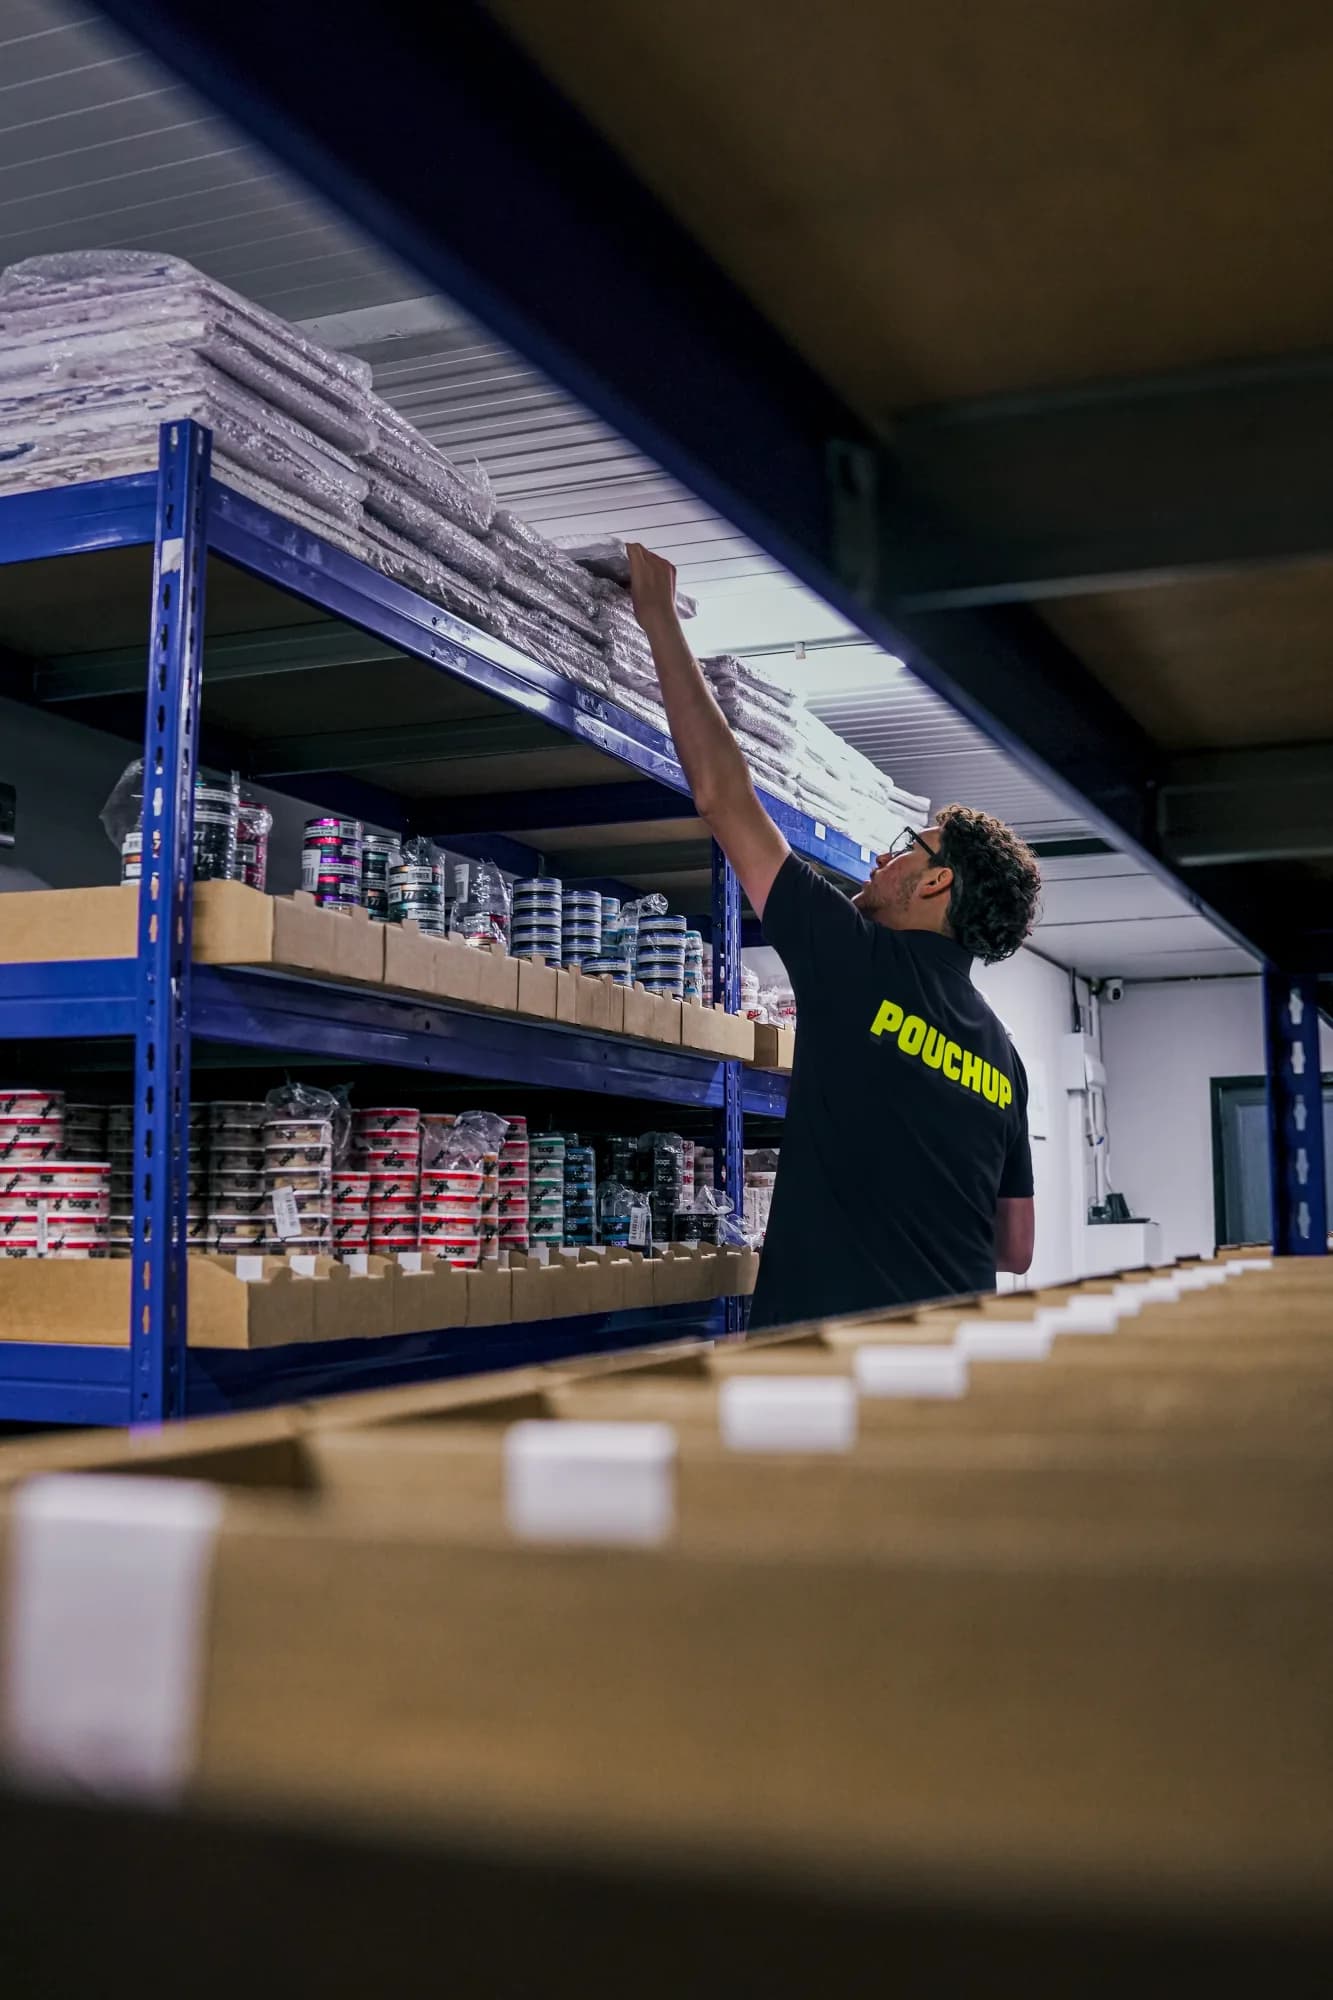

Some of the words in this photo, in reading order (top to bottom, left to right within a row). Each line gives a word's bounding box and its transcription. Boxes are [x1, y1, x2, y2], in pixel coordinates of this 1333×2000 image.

[403, 891, 414, 900] 77
[870, 999, 1012, 1110] POUCHUP
[445, 1246, 464, 1256] bagz
